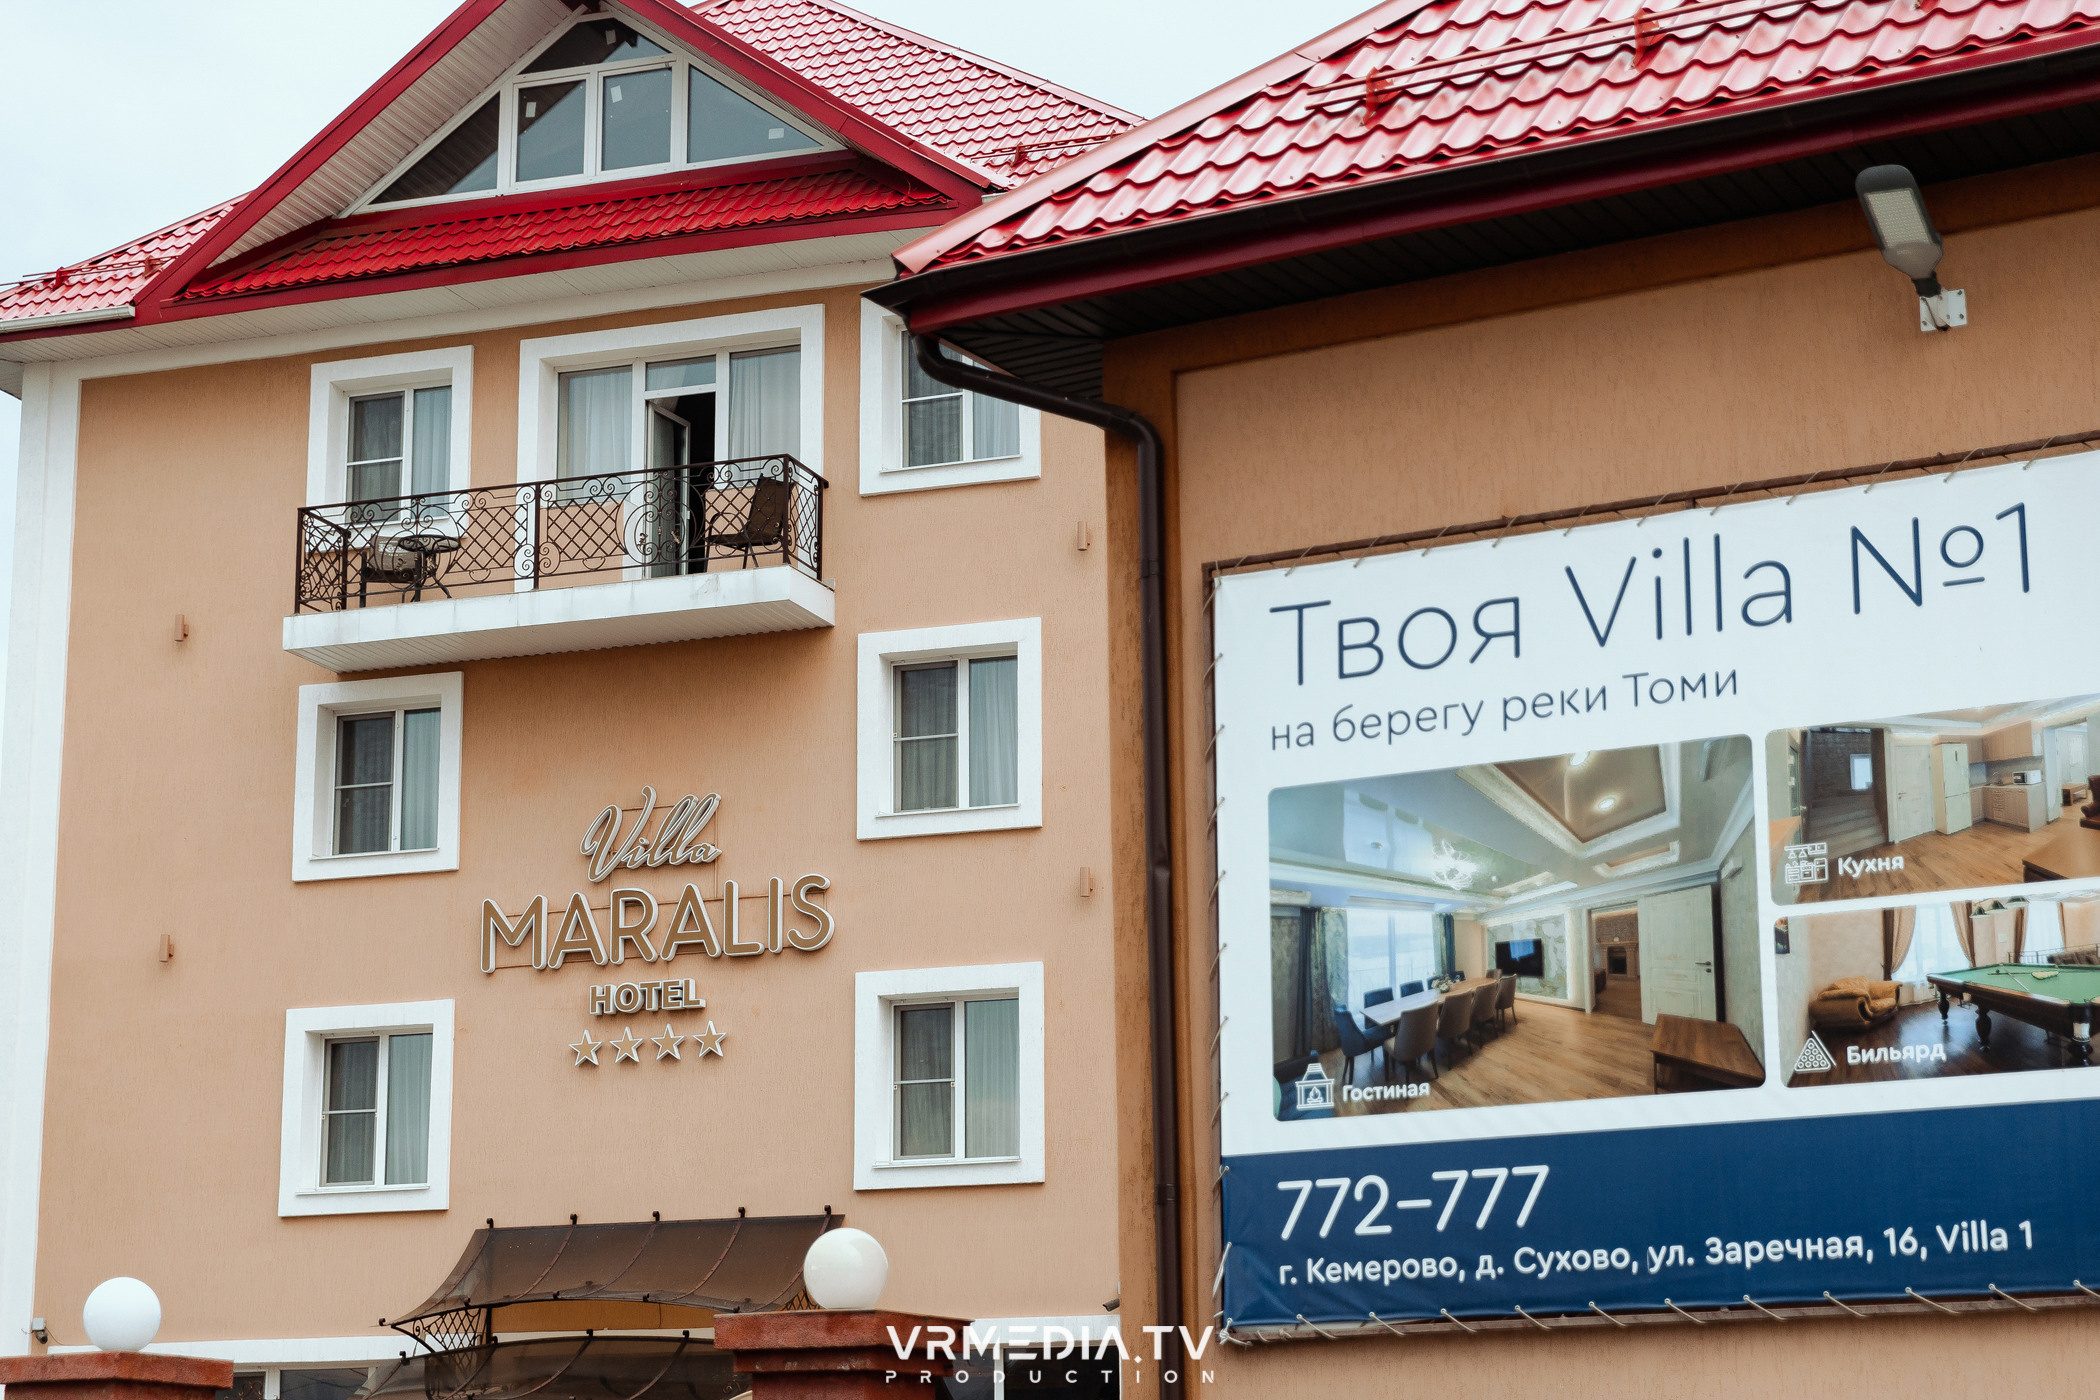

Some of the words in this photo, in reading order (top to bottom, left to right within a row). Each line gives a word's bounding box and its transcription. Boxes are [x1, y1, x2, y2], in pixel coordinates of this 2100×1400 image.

[1269, 596, 1521, 686] Твоя
[1564, 531, 1793, 648] Villa
[1271, 720, 1315, 751] на
[1332, 699, 1484, 745] берегу
[1502, 685, 1608, 732] реки
[1622, 668, 1738, 707] Томи
[579, 785, 722, 883] Villa
[1837, 855, 1905, 879] Кухня
[480, 872, 836, 974] MARALIS
[589, 977, 706, 1015] HOTEL
[1846, 1042, 1947, 1067] Бильярд
[1342, 1082, 1431, 1102] Гостиная
[1279, 1264, 1298, 1285] г.
[1306, 1255, 1466, 1286] Кемерово,
[1475, 1254, 1504, 1280] д.
[1513, 1246, 1639, 1279] Сухово,
[1647, 1243, 1695, 1274] ул.
[1704, 1235, 1875, 1269] Заречная,
[1883, 1226, 1928, 1262] 16,
[1935, 1219, 2009, 1254] Villa
[2018, 1220, 2034, 1250] 1
